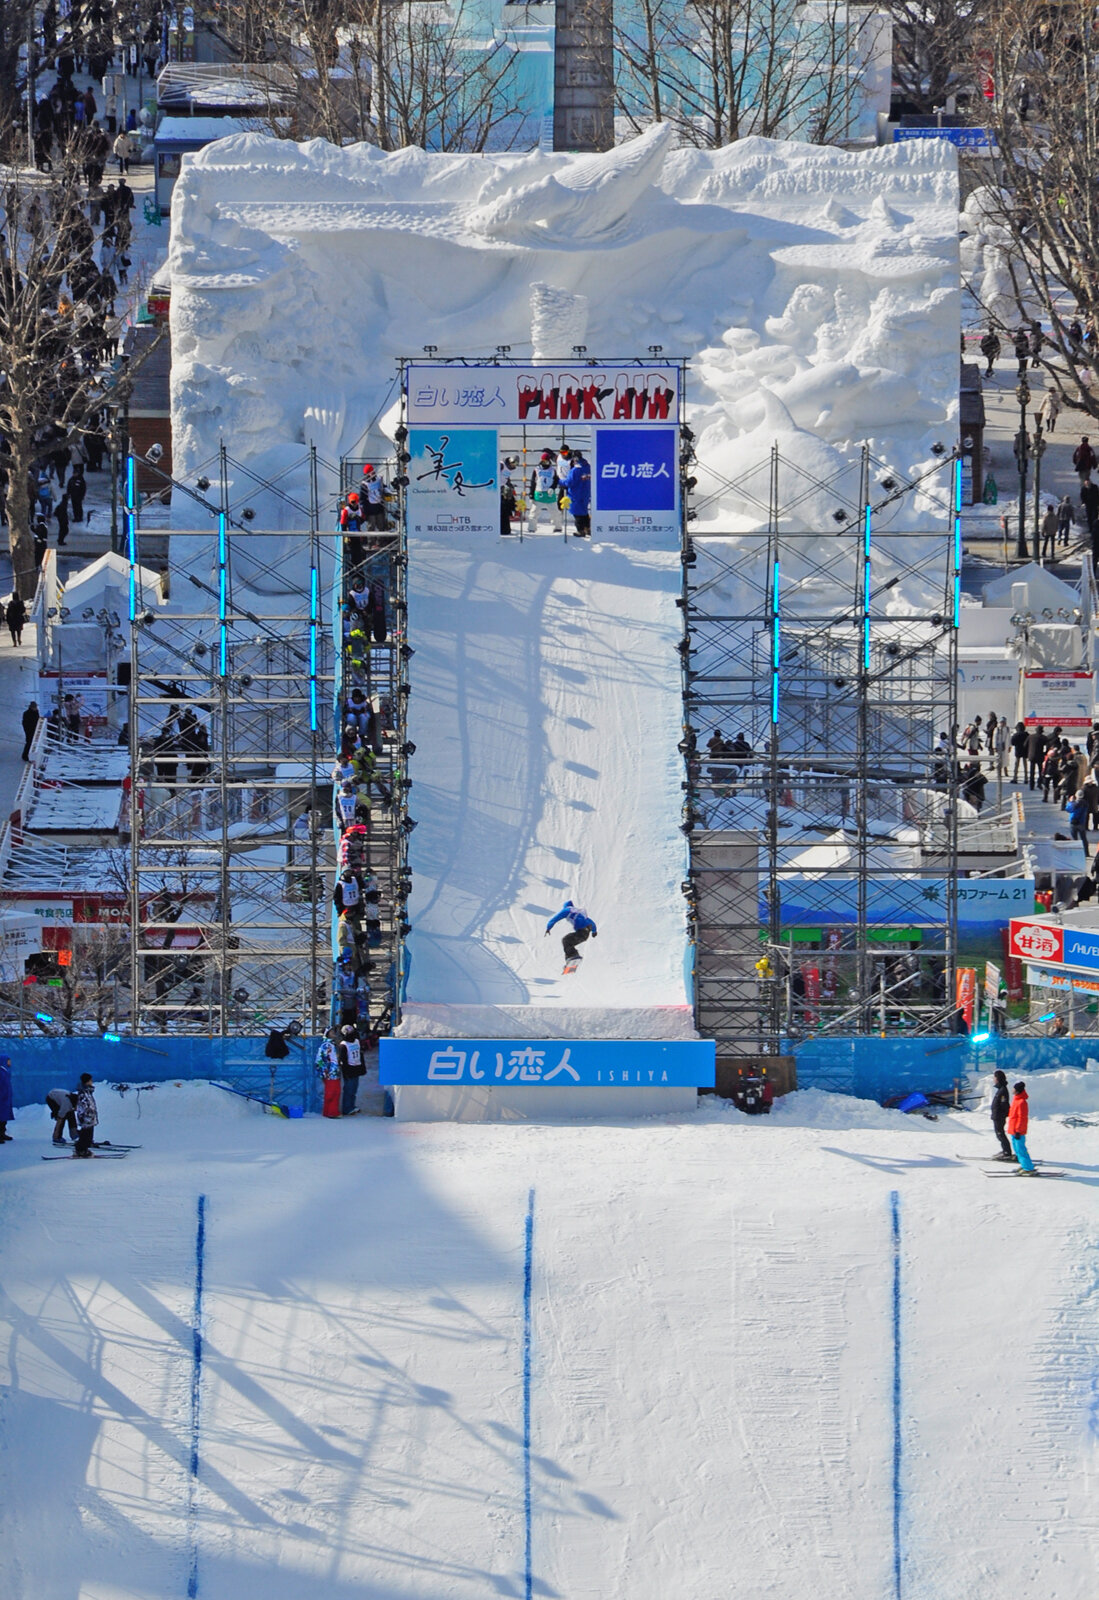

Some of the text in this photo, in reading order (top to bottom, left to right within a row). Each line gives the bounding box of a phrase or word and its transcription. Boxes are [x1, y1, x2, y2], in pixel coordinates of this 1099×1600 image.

[413, 373, 674, 420] 白い恋人 PARK AIR
[601, 462, 670, 478] 白い恋人
[452, 516, 471, 524] HTB
[634, 517, 653, 525] HTB
[1012, 888, 1027, 900] 21
[98, 908, 131, 918] MOA
[1019, 935, 1054, 952] 甘酒
[427, 1046, 669, 1082] 白い恋人 ISHIYA
